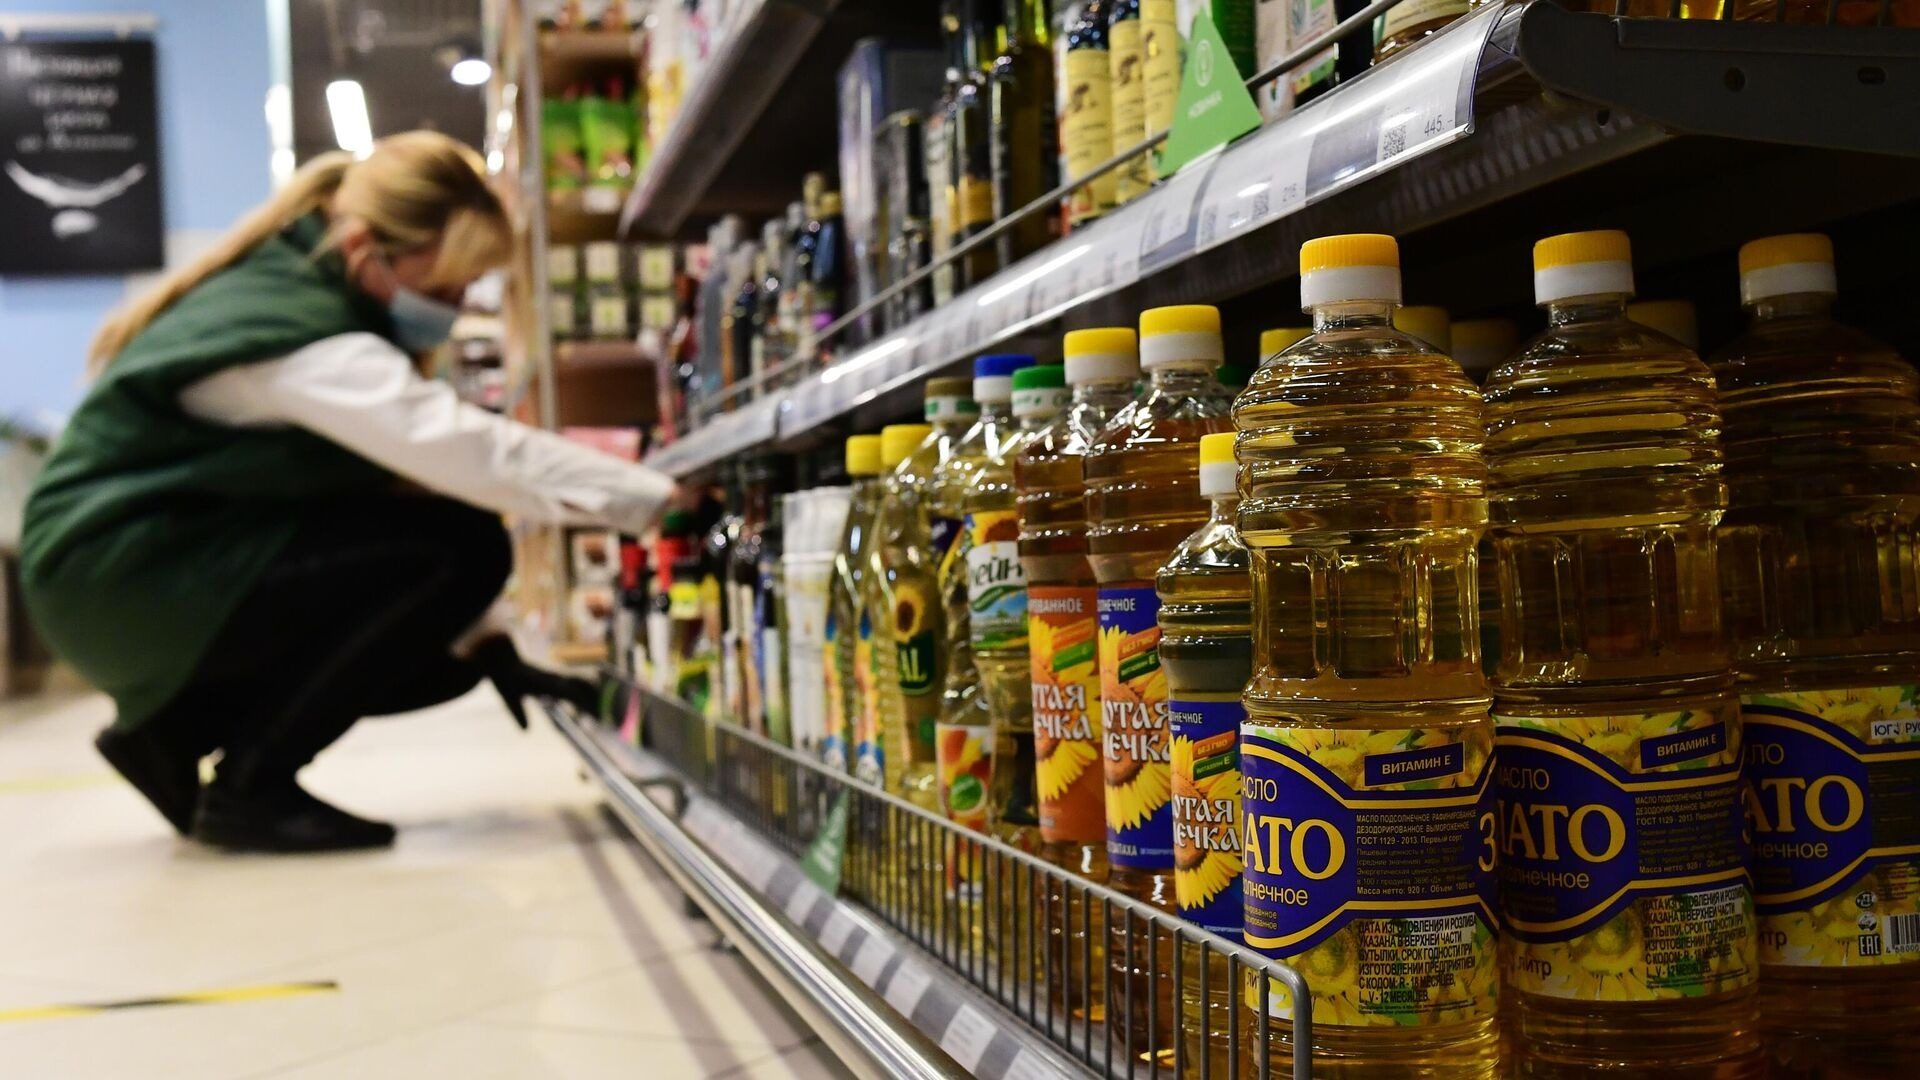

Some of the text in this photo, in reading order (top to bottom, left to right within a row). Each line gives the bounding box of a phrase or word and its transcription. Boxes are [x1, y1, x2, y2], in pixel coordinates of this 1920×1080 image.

[1656, 736, 1708, 758] ВИТАМИН
[1381, 757, 1443, 776] ВИТАМИН
[1240, 810, 1347, 881] АТО
[1356, 836, 1377, 846] ГОСТ
[1356, 885, 1380, 896] Масса
[1407, 885, 1421, 896] 920
[1441, 930, 1462, 944] ЧАСТИ
[1401, 947, 1423, 961] СРОК
[1424, 944, 1460, 961] ГОДНОСТИ
